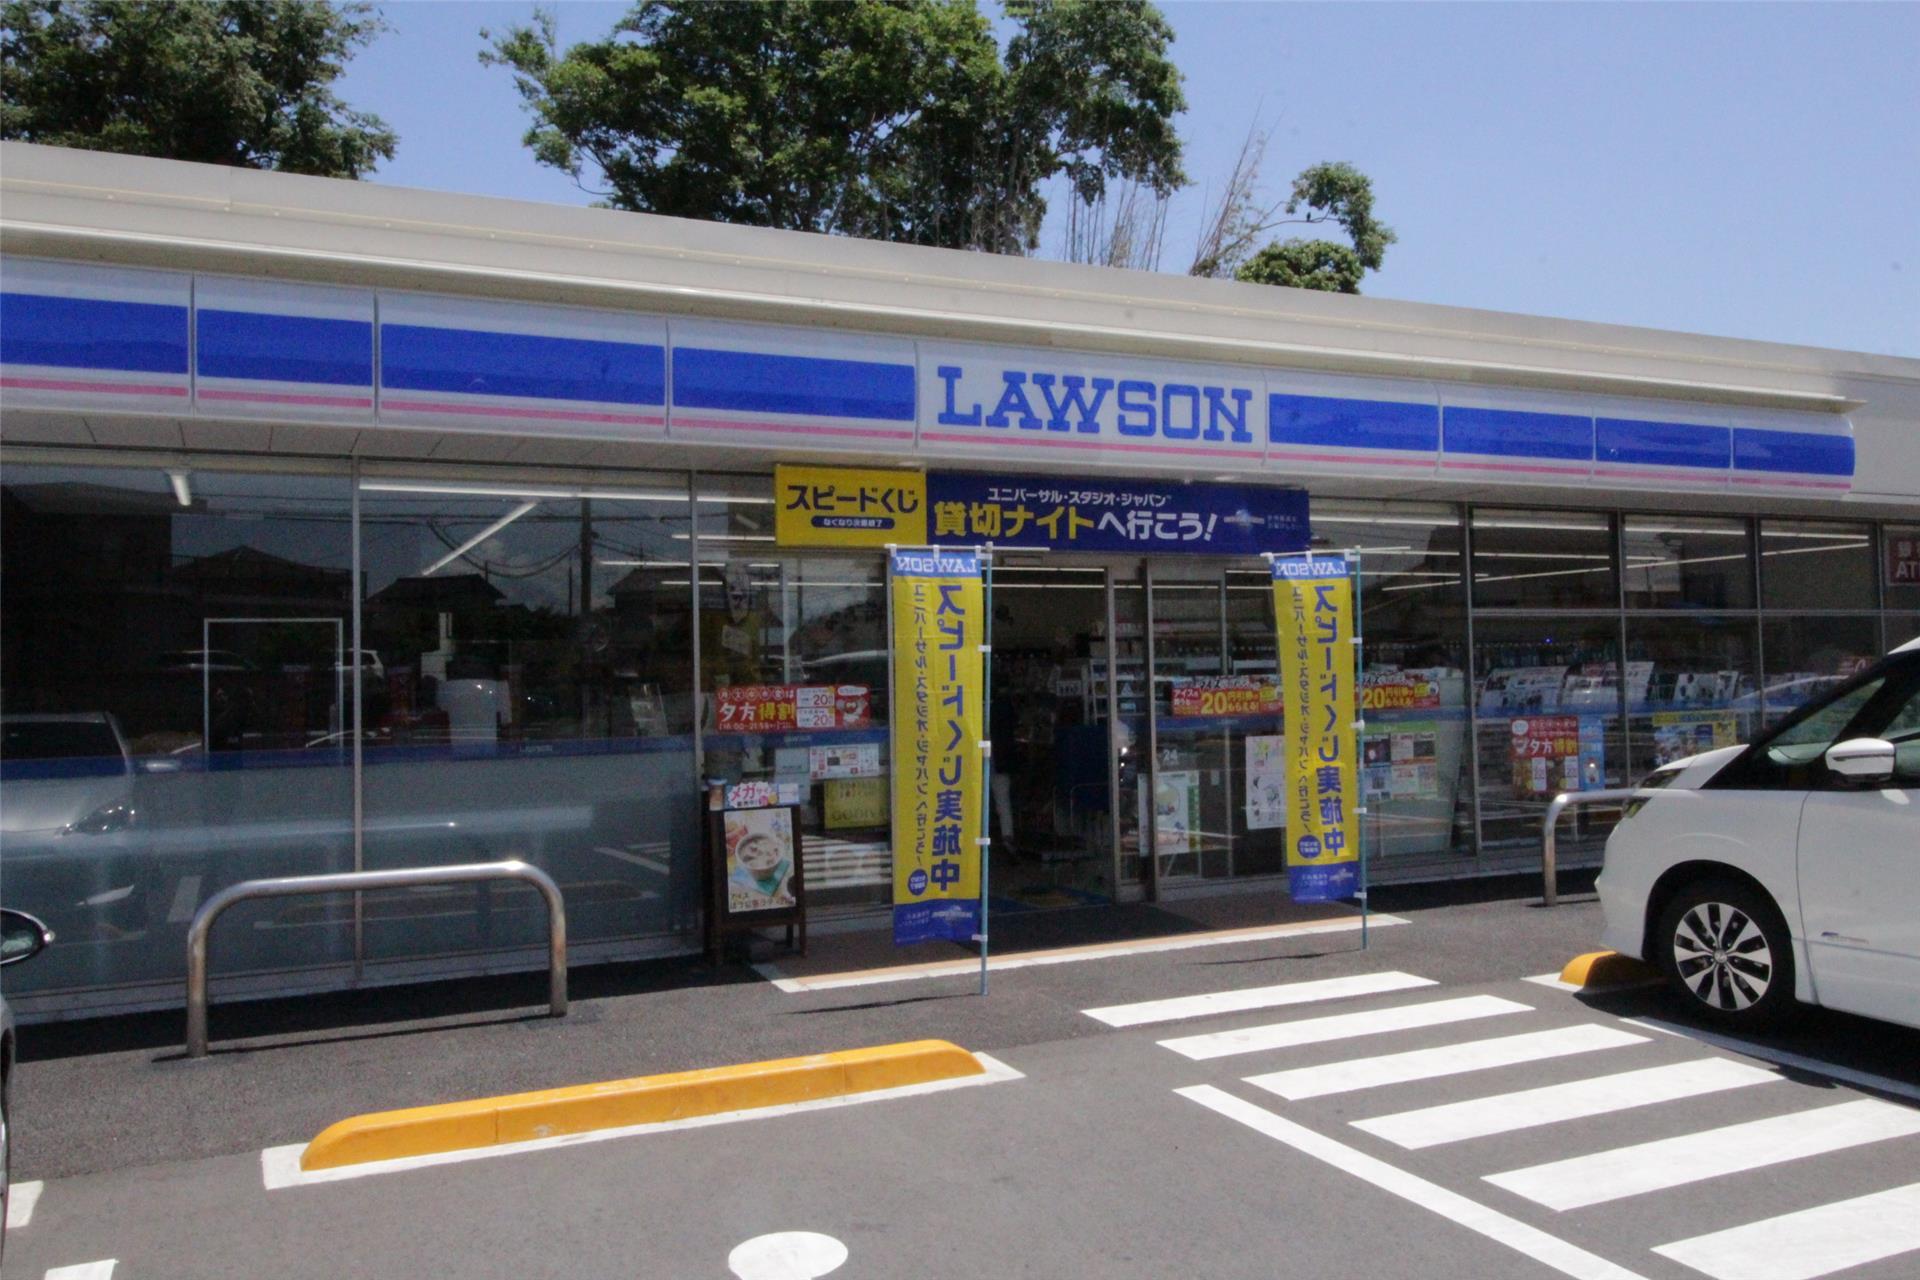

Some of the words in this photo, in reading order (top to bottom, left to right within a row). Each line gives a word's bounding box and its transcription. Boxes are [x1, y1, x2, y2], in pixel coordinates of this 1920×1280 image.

[938, 365, 1252, 442] LAWSON
[786, 485, 918, 513] スピードくじ
[1896, 561, 1920, 579] AT
[1200, 691, 1227, 714] 20
